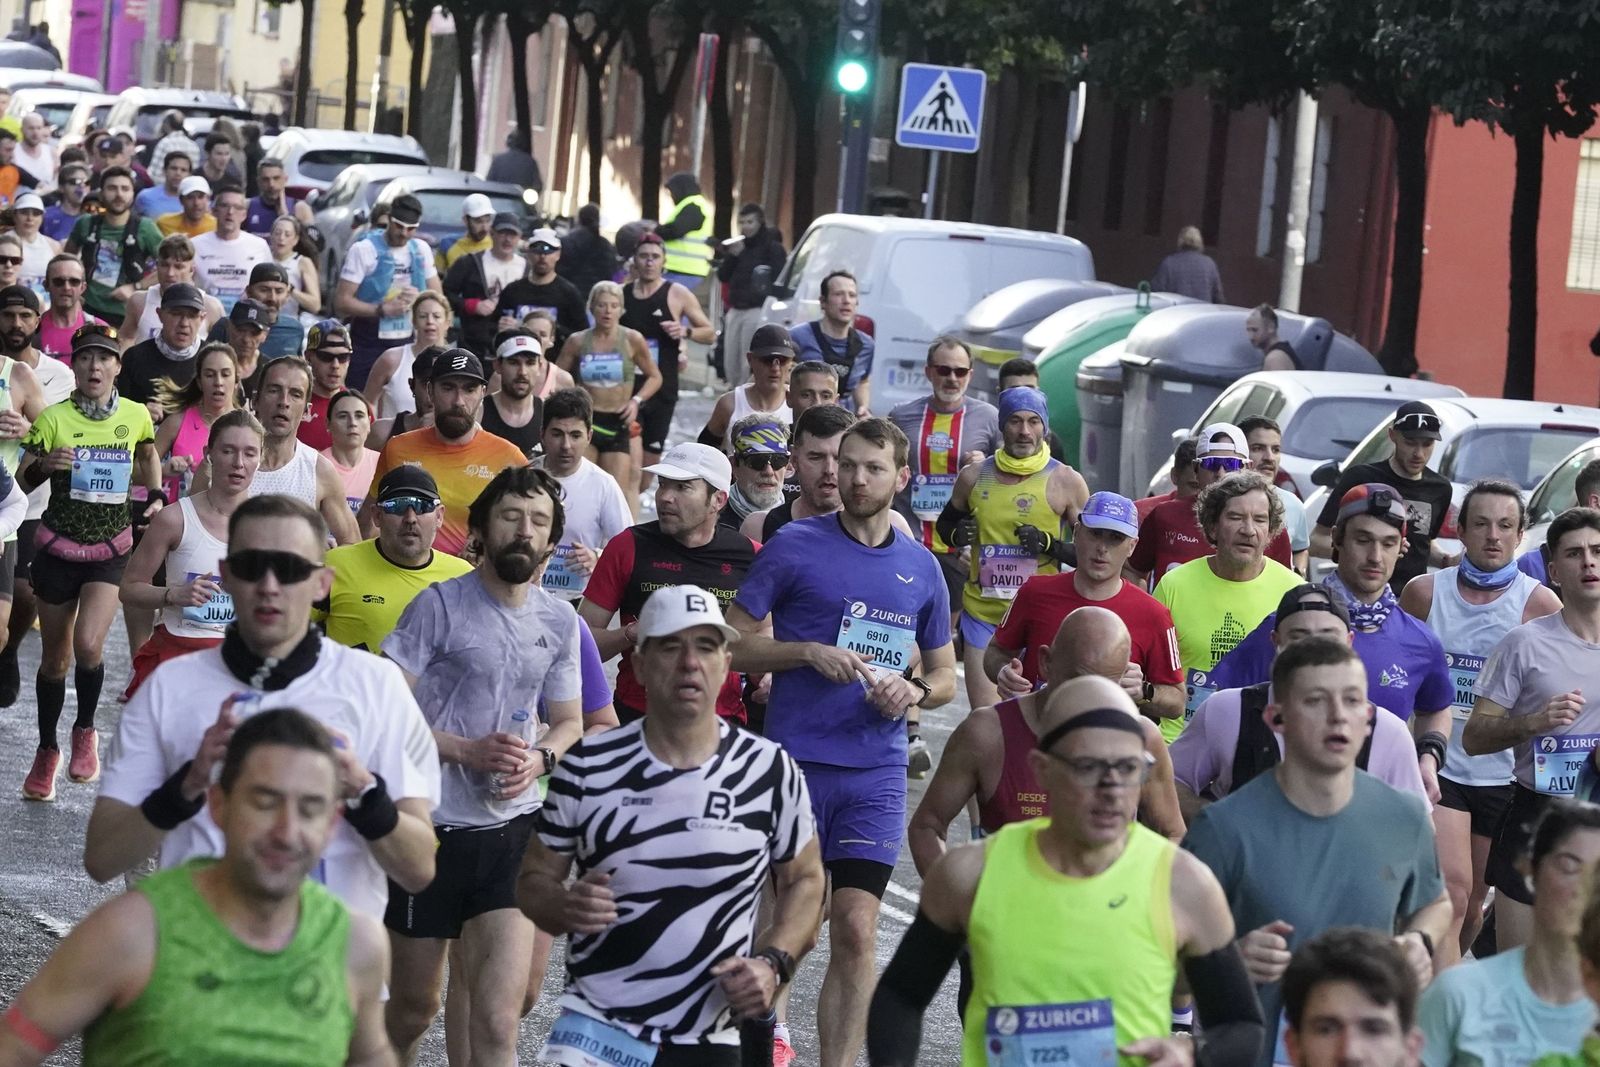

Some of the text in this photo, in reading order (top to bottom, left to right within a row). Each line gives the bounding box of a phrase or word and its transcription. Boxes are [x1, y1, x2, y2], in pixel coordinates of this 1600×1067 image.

[94, 452, 126, 461] ZURICH
[90, 479, 114, 490] FITO
[991, 574, 1024, 586] DAVID
[204, 607, 235, 620] JUJU
[870, 608, 911, 626] ZURICH
[866, 630, 889, 643] 6910
[847, 641, 903, 666] ANDRAS
[1017, 792, 1047, 803] DESDE
[1021, 806, 1042, 816] 1985
[1024, 1006, 1099, 1028] ZURICH
[1030, 1045, 1070, 1064] 7225
